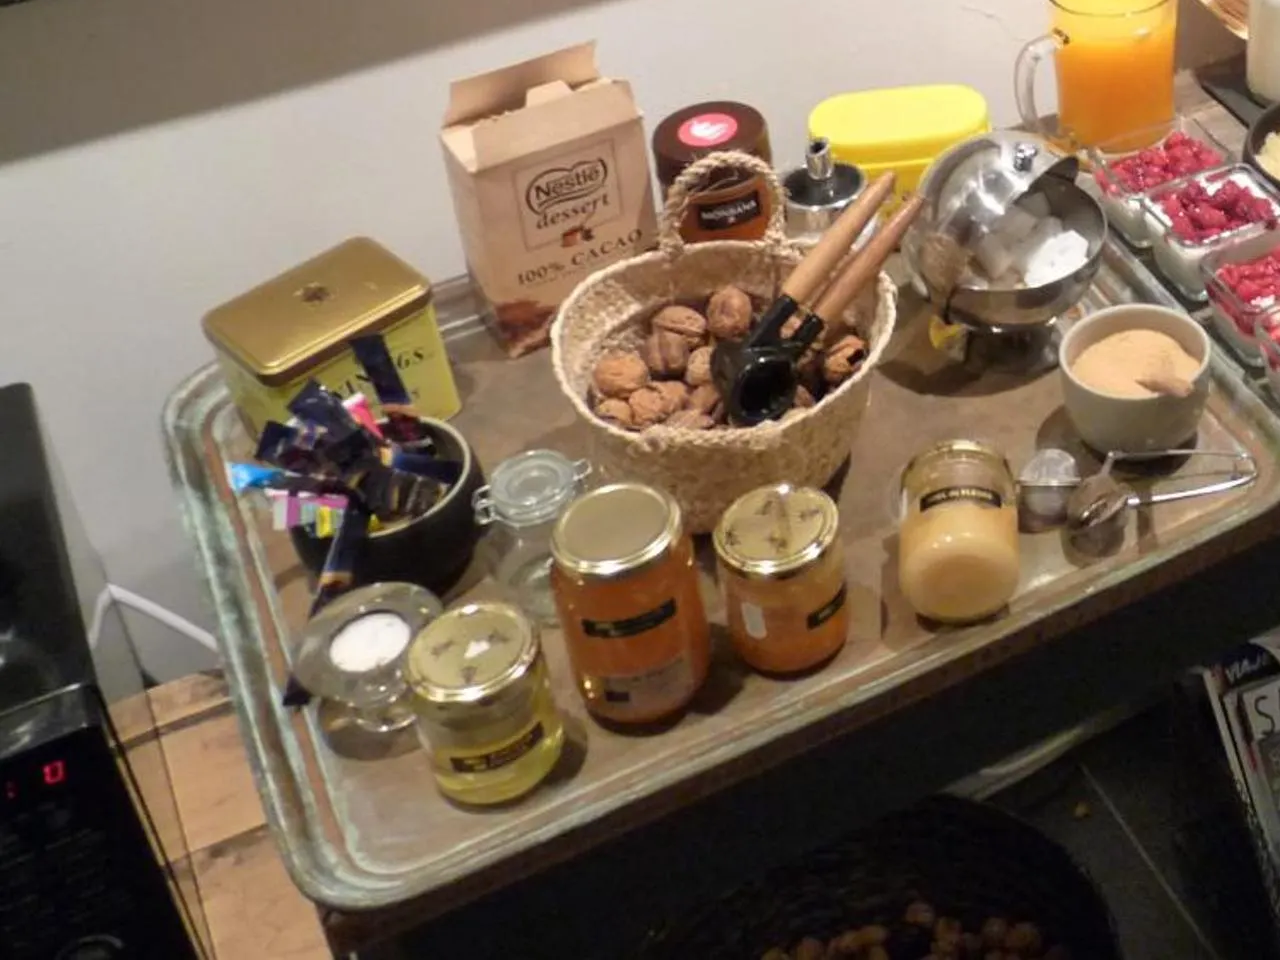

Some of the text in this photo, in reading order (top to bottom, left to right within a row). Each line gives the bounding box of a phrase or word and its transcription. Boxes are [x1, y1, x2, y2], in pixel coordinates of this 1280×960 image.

[536, 193, 610, 230] dessert
[517, 228, 643, 286] 100% CACAO
